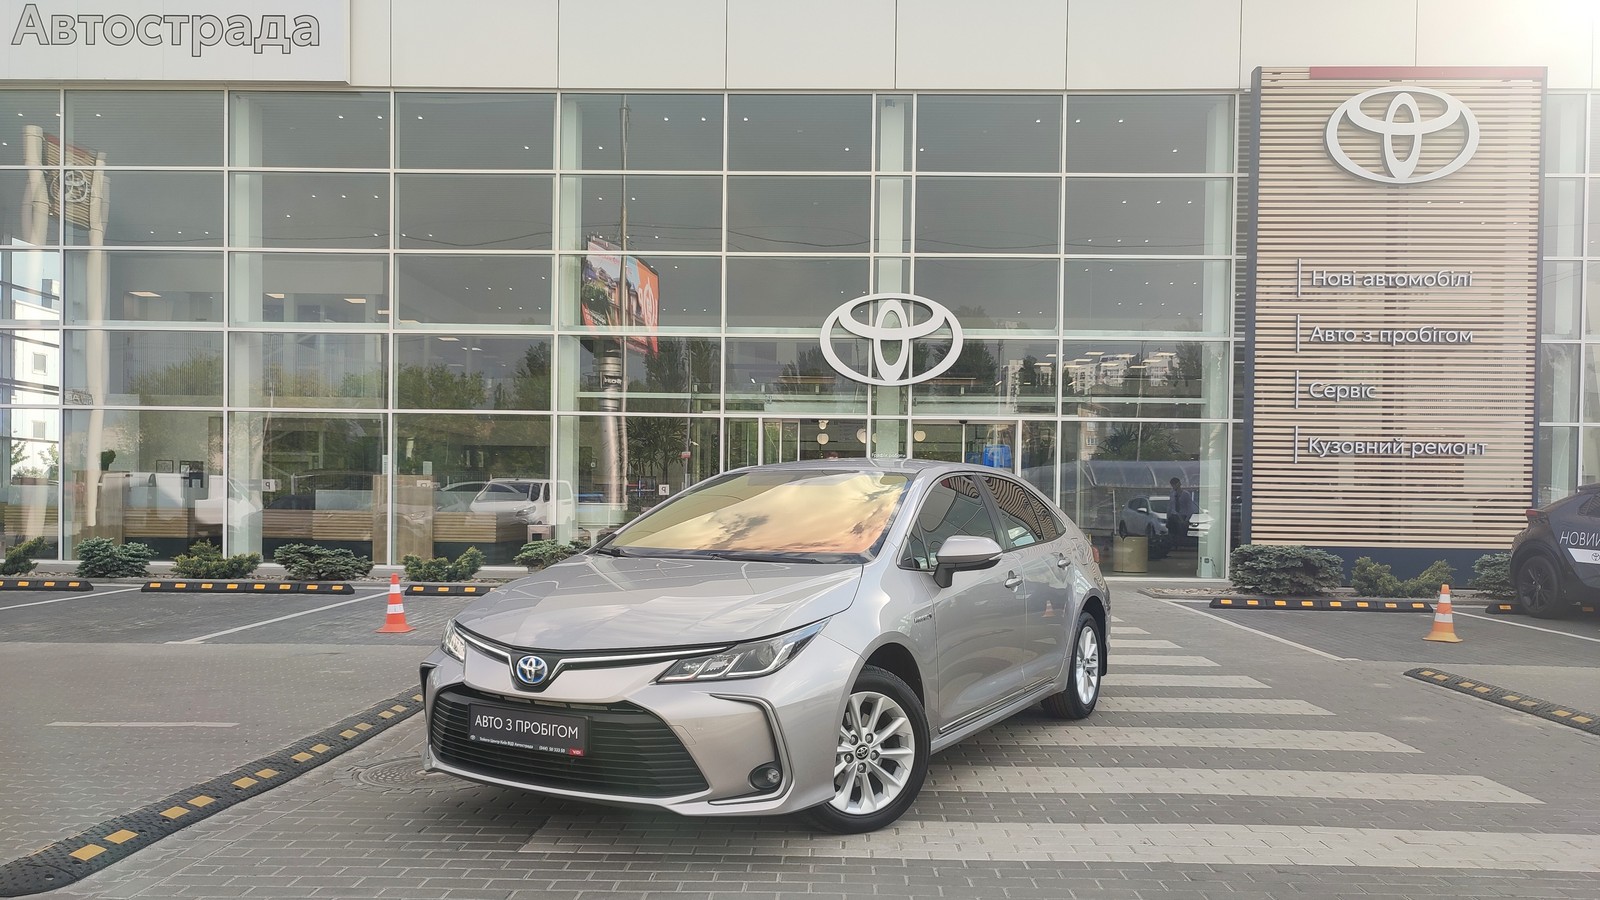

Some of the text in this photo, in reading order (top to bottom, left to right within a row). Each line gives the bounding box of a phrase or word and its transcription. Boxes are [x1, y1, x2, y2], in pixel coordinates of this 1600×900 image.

[11, 3, 321, 58] Автострада
[1311, 270, 1473, 288] Нові автомобілі
[1309, 326, 1474, 347] Авто з пробігом
[1308, 382, 1377, 402] Сервіс
[1307, 437, 1489, 458] Кузовний ремонт
[474, 714, 503, 730] АВТО
[515, 719, 579, 740] ПРОБІГОМ
